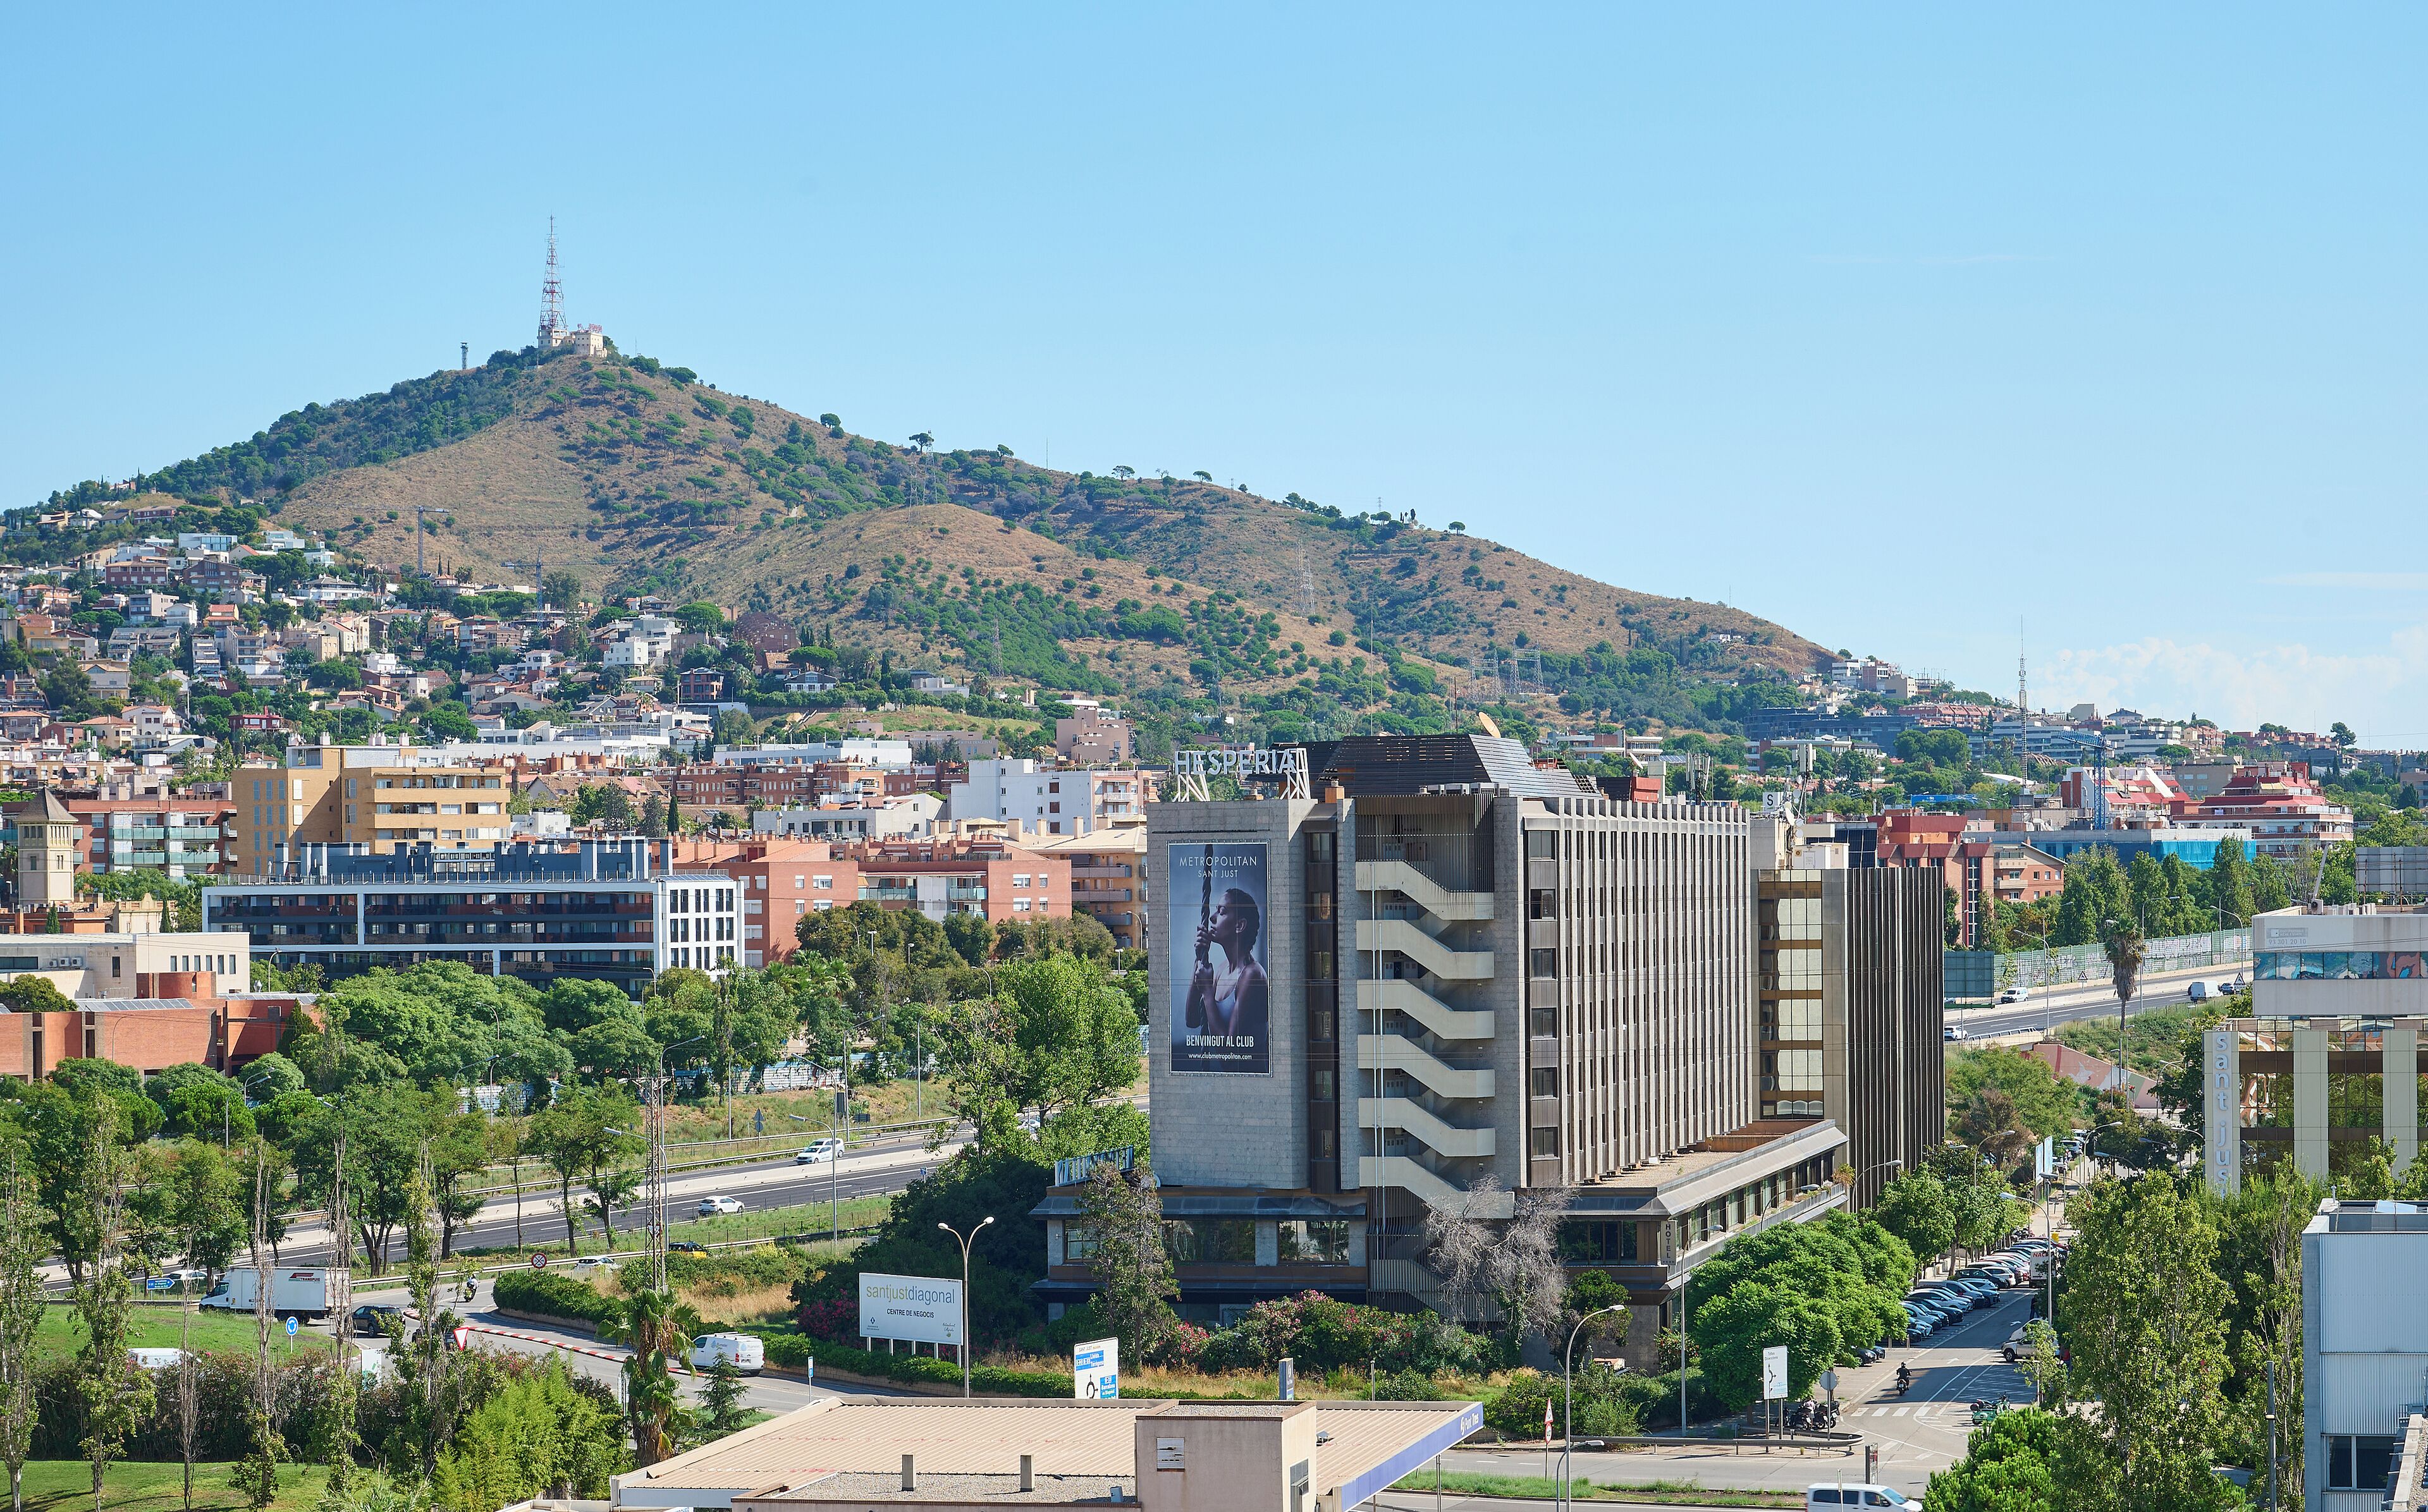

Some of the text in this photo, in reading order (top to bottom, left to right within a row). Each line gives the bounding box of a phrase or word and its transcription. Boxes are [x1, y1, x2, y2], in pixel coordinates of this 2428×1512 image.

[1174, 750, 1297, 775] HESPERIA
[1767, 794, 1774, 807] S
[1179, 856, 1257, 867] METROPOLITAN
[1198, 870, 1238, 878] SANT JUST
[1186, 1035, 1254, 1047] BENVINGUT AL CLUB
[1188, 1052, 1253, 1061] www.clubmetropolitan.com
[2215, 1035, 2229, 1111] sant
[866, 1284, 955, 1305] santjustdiagonal
